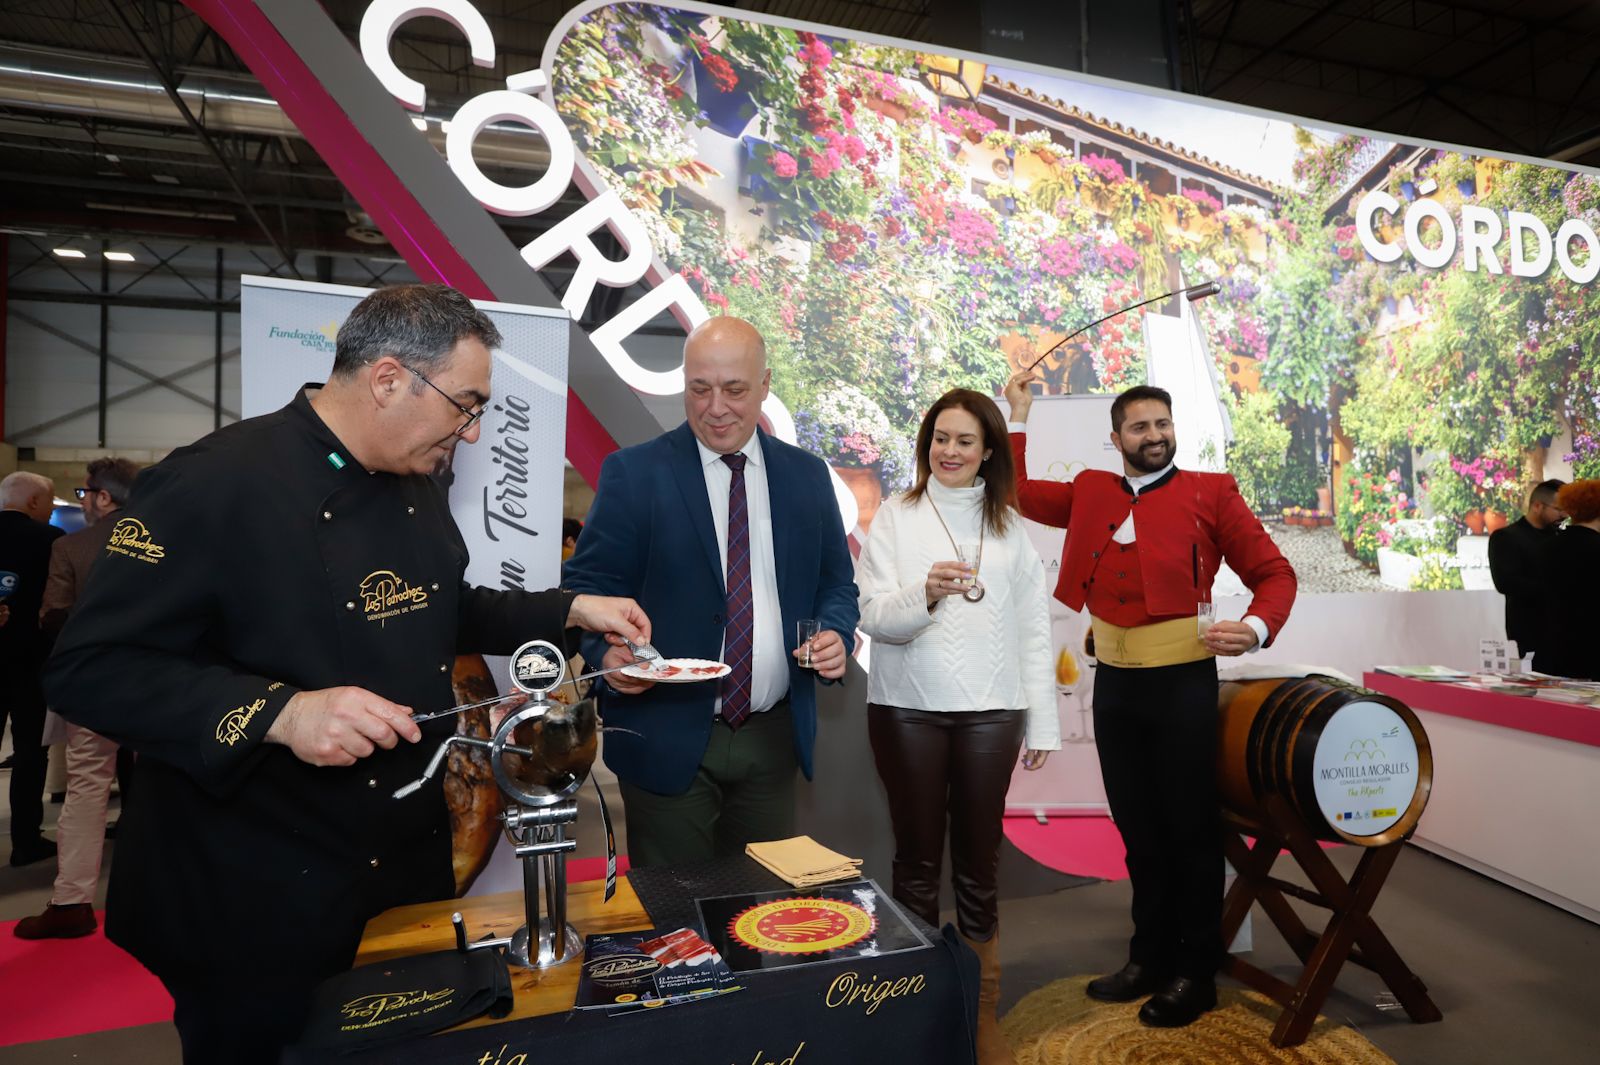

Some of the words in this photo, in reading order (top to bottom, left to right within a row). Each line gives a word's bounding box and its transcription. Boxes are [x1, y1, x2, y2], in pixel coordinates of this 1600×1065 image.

[269, 326, 325, 342] Fundación
[483, 394, 539, 542] Territorio
[1320, 766, 1366, 780] MONTILLA
[824, 970, 926, 1014] Origen
